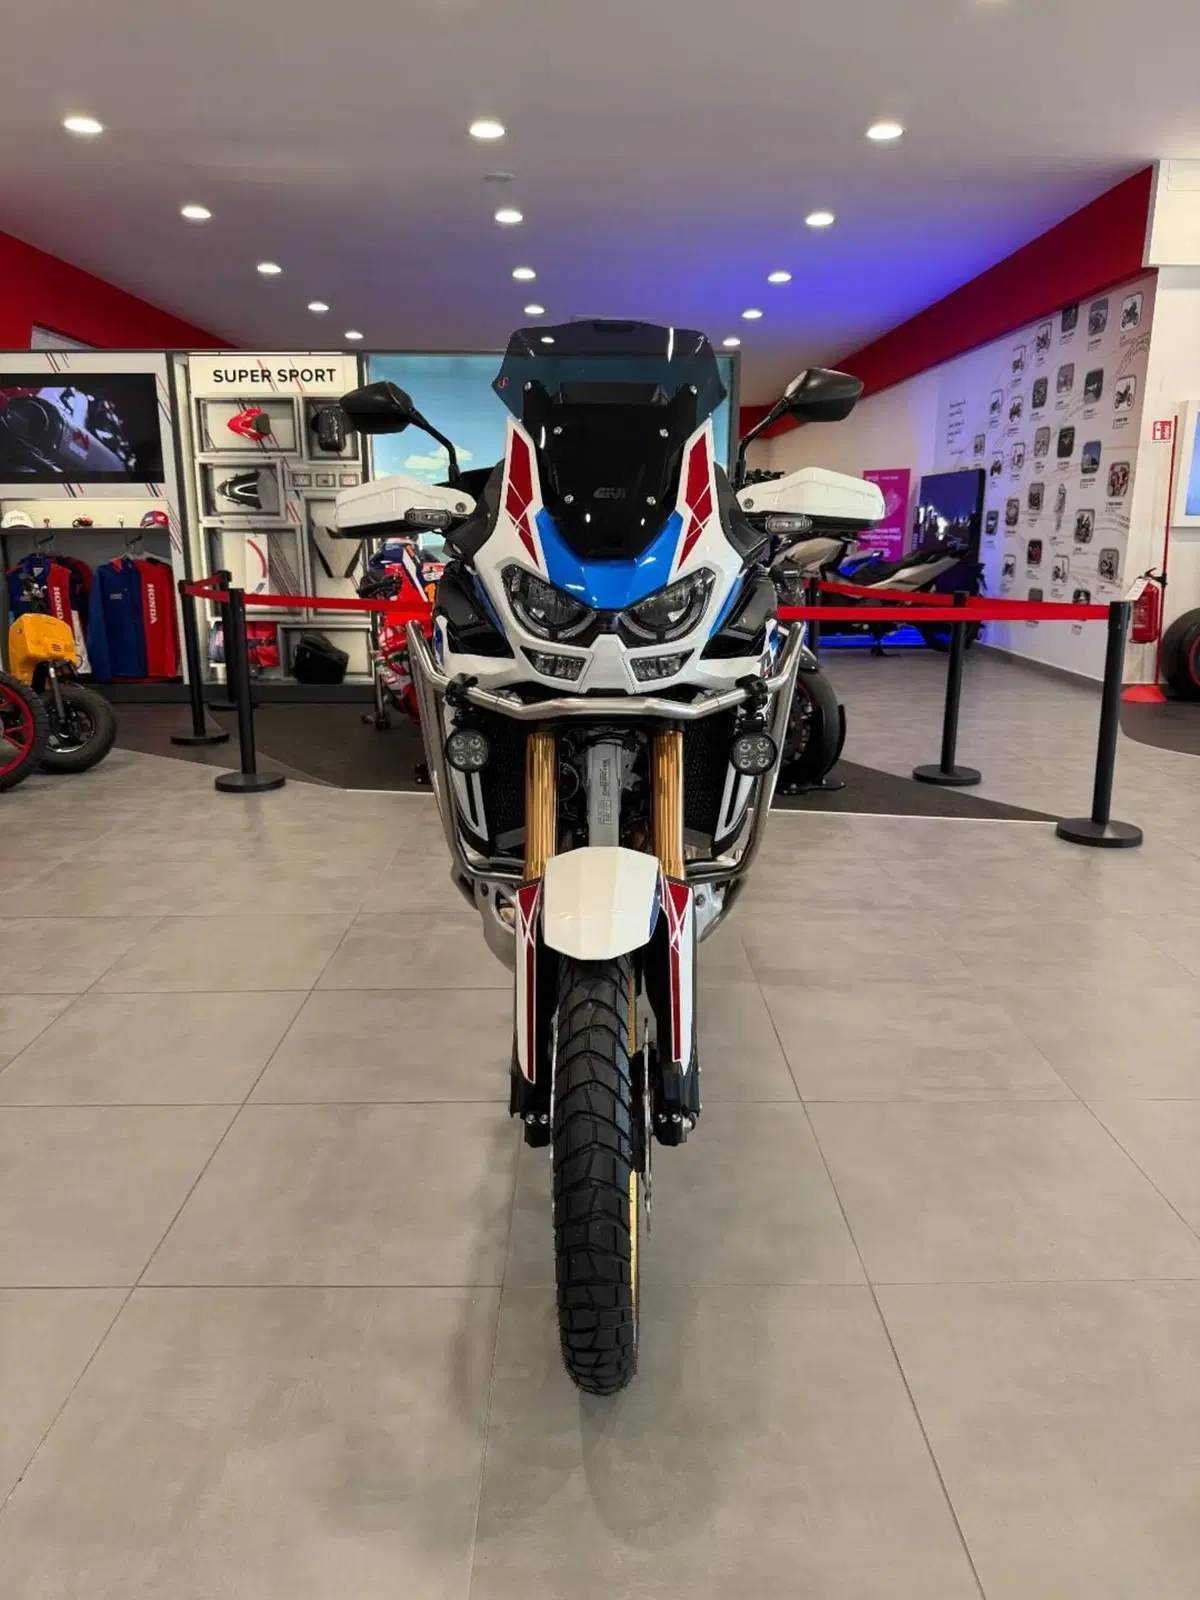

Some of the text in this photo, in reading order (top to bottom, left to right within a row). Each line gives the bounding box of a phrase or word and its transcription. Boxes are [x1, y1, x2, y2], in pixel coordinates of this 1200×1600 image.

[213, 368, 336, 383] SUPER SPORT
[593, 487, 626, 500] GIVI
[53, 586, 64, 620] HOND
[146, 583, 157, 625] HONDA
